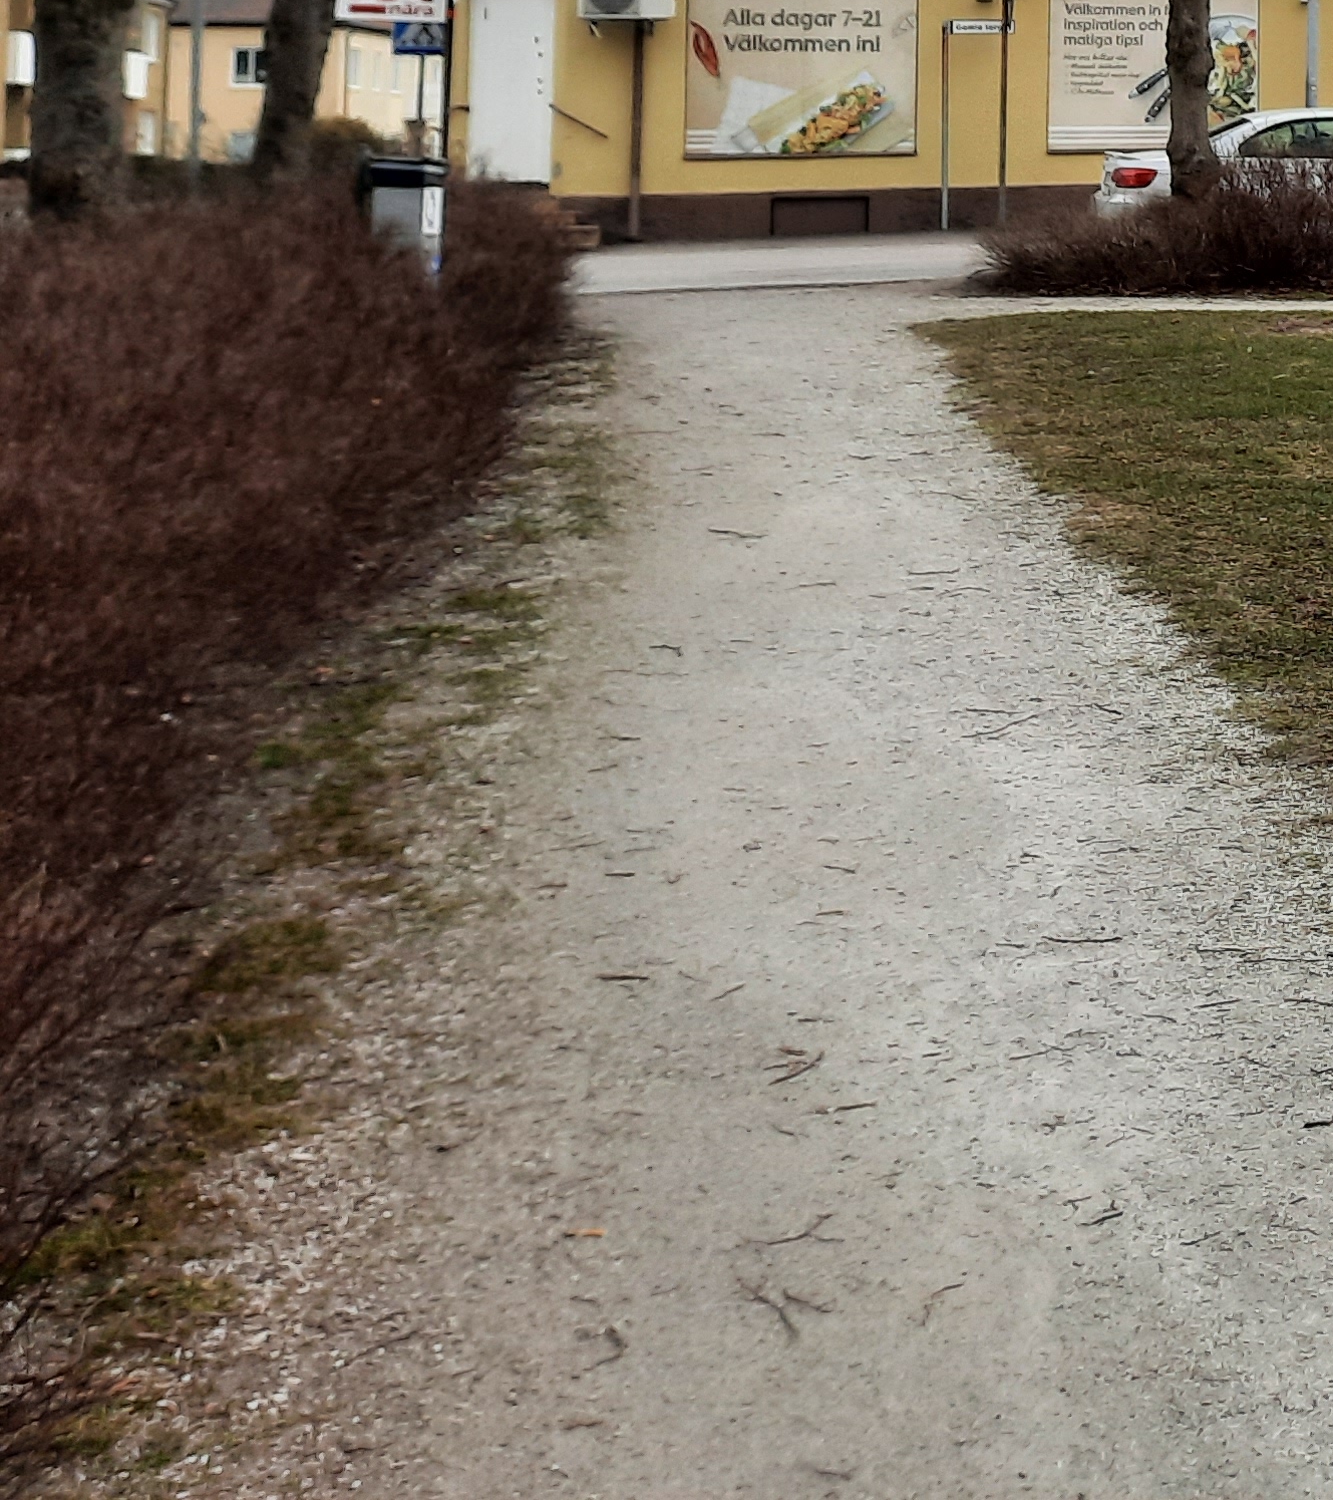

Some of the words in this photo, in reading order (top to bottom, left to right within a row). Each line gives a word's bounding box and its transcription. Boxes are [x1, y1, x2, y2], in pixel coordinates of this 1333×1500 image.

[1064, 2, 1146, 16] Välkommen
[1149, 4, 1161, 16] in
[723, 7, 765, 27] Alla
[771, 8, 837, 30] dagar
[1138, 18, 1163, 31] och
[723, 33, 851, 53] Välkommen
[856, 34, 881, 53] in!
[1115, 34, 1144, 48] tips!
